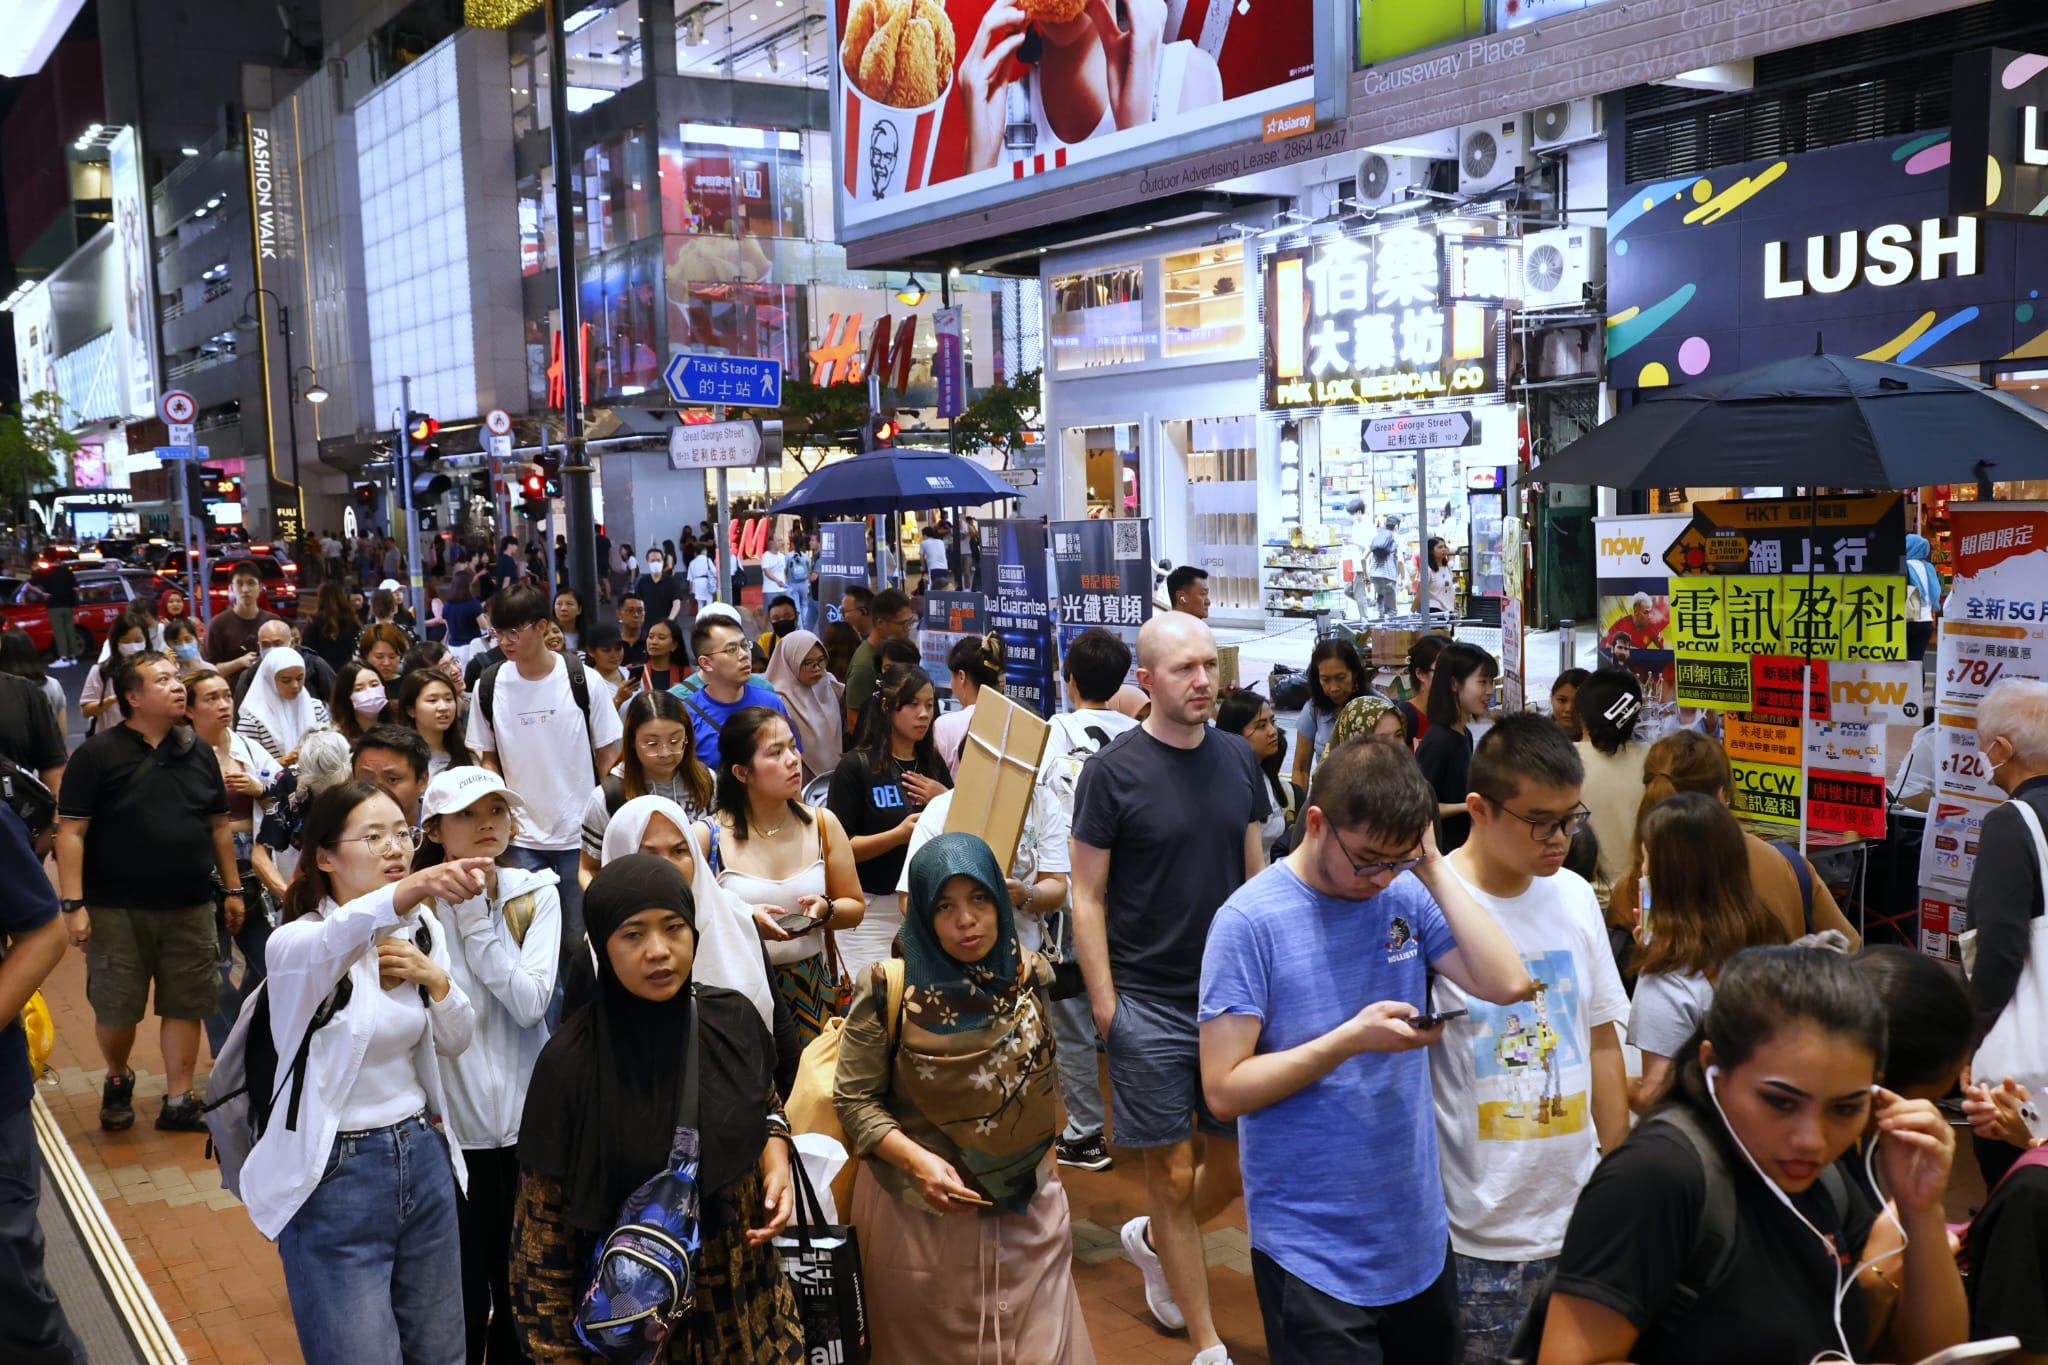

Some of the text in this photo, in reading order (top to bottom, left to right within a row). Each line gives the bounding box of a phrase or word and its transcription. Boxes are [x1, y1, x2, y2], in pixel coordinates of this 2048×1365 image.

[1364, 36, 1526, 96] Causeway Place
[1478, 85, 1529, 114] Place
[1278, 114, 1311, 132] Asiaray
[1139, 128, 1348, 194] Outdoor Advertising Lease: 2864 4247
[253, 128, 277, 259] FASHION WALK
[1764, 216, 1978, 299] LUSH
[692, 360, 758, 376] Taxi Stand
[699, 379, 751, 397] 的士站
[1317, 378, 1357, 402] LOK
[1360, 370, 1447, 399] MEDICAL
[1453, 366, 1485, 391] CO
[682, 427, 745, 442] Great George Street
[1374, 418, 1452, 432] Great George Street
[1387, 432, 1438, 447] 記利佐治街
[1745, 505, 1782, 522] HKT
[1601, 536, 1645, 557] now
[1960, 524, 2034, 557] 期間限定
[1641, 556, 1650, 564] TV
[1749, 537, 1868, 574] 網上行
[984, 595, 1047, 616] Dual Guarantee
[1062, 594, 1143, 623] 光纖寬頻
[1670, 584, 1906, 643] 電訊盈科
[1677, 640, 1719, 652] PCCW
[1732, 641, 1777, 655] PCCW
[1790, 641, 1836, 655] PCCW
[1848, 645, 1900, 660] PCCW
[1678, 663, 1748, 687] 固網電話
[1831, 681, 1908, 705] now
[1904, 706, 1917, 714] TV
[1840, 722, 1869, 730] PCCW
[1732, 768, 1796, 795] PCCW
[1735, 792, 1796, 817] 電訊盈科
[852, 1272, 865, 1332] lululemon
